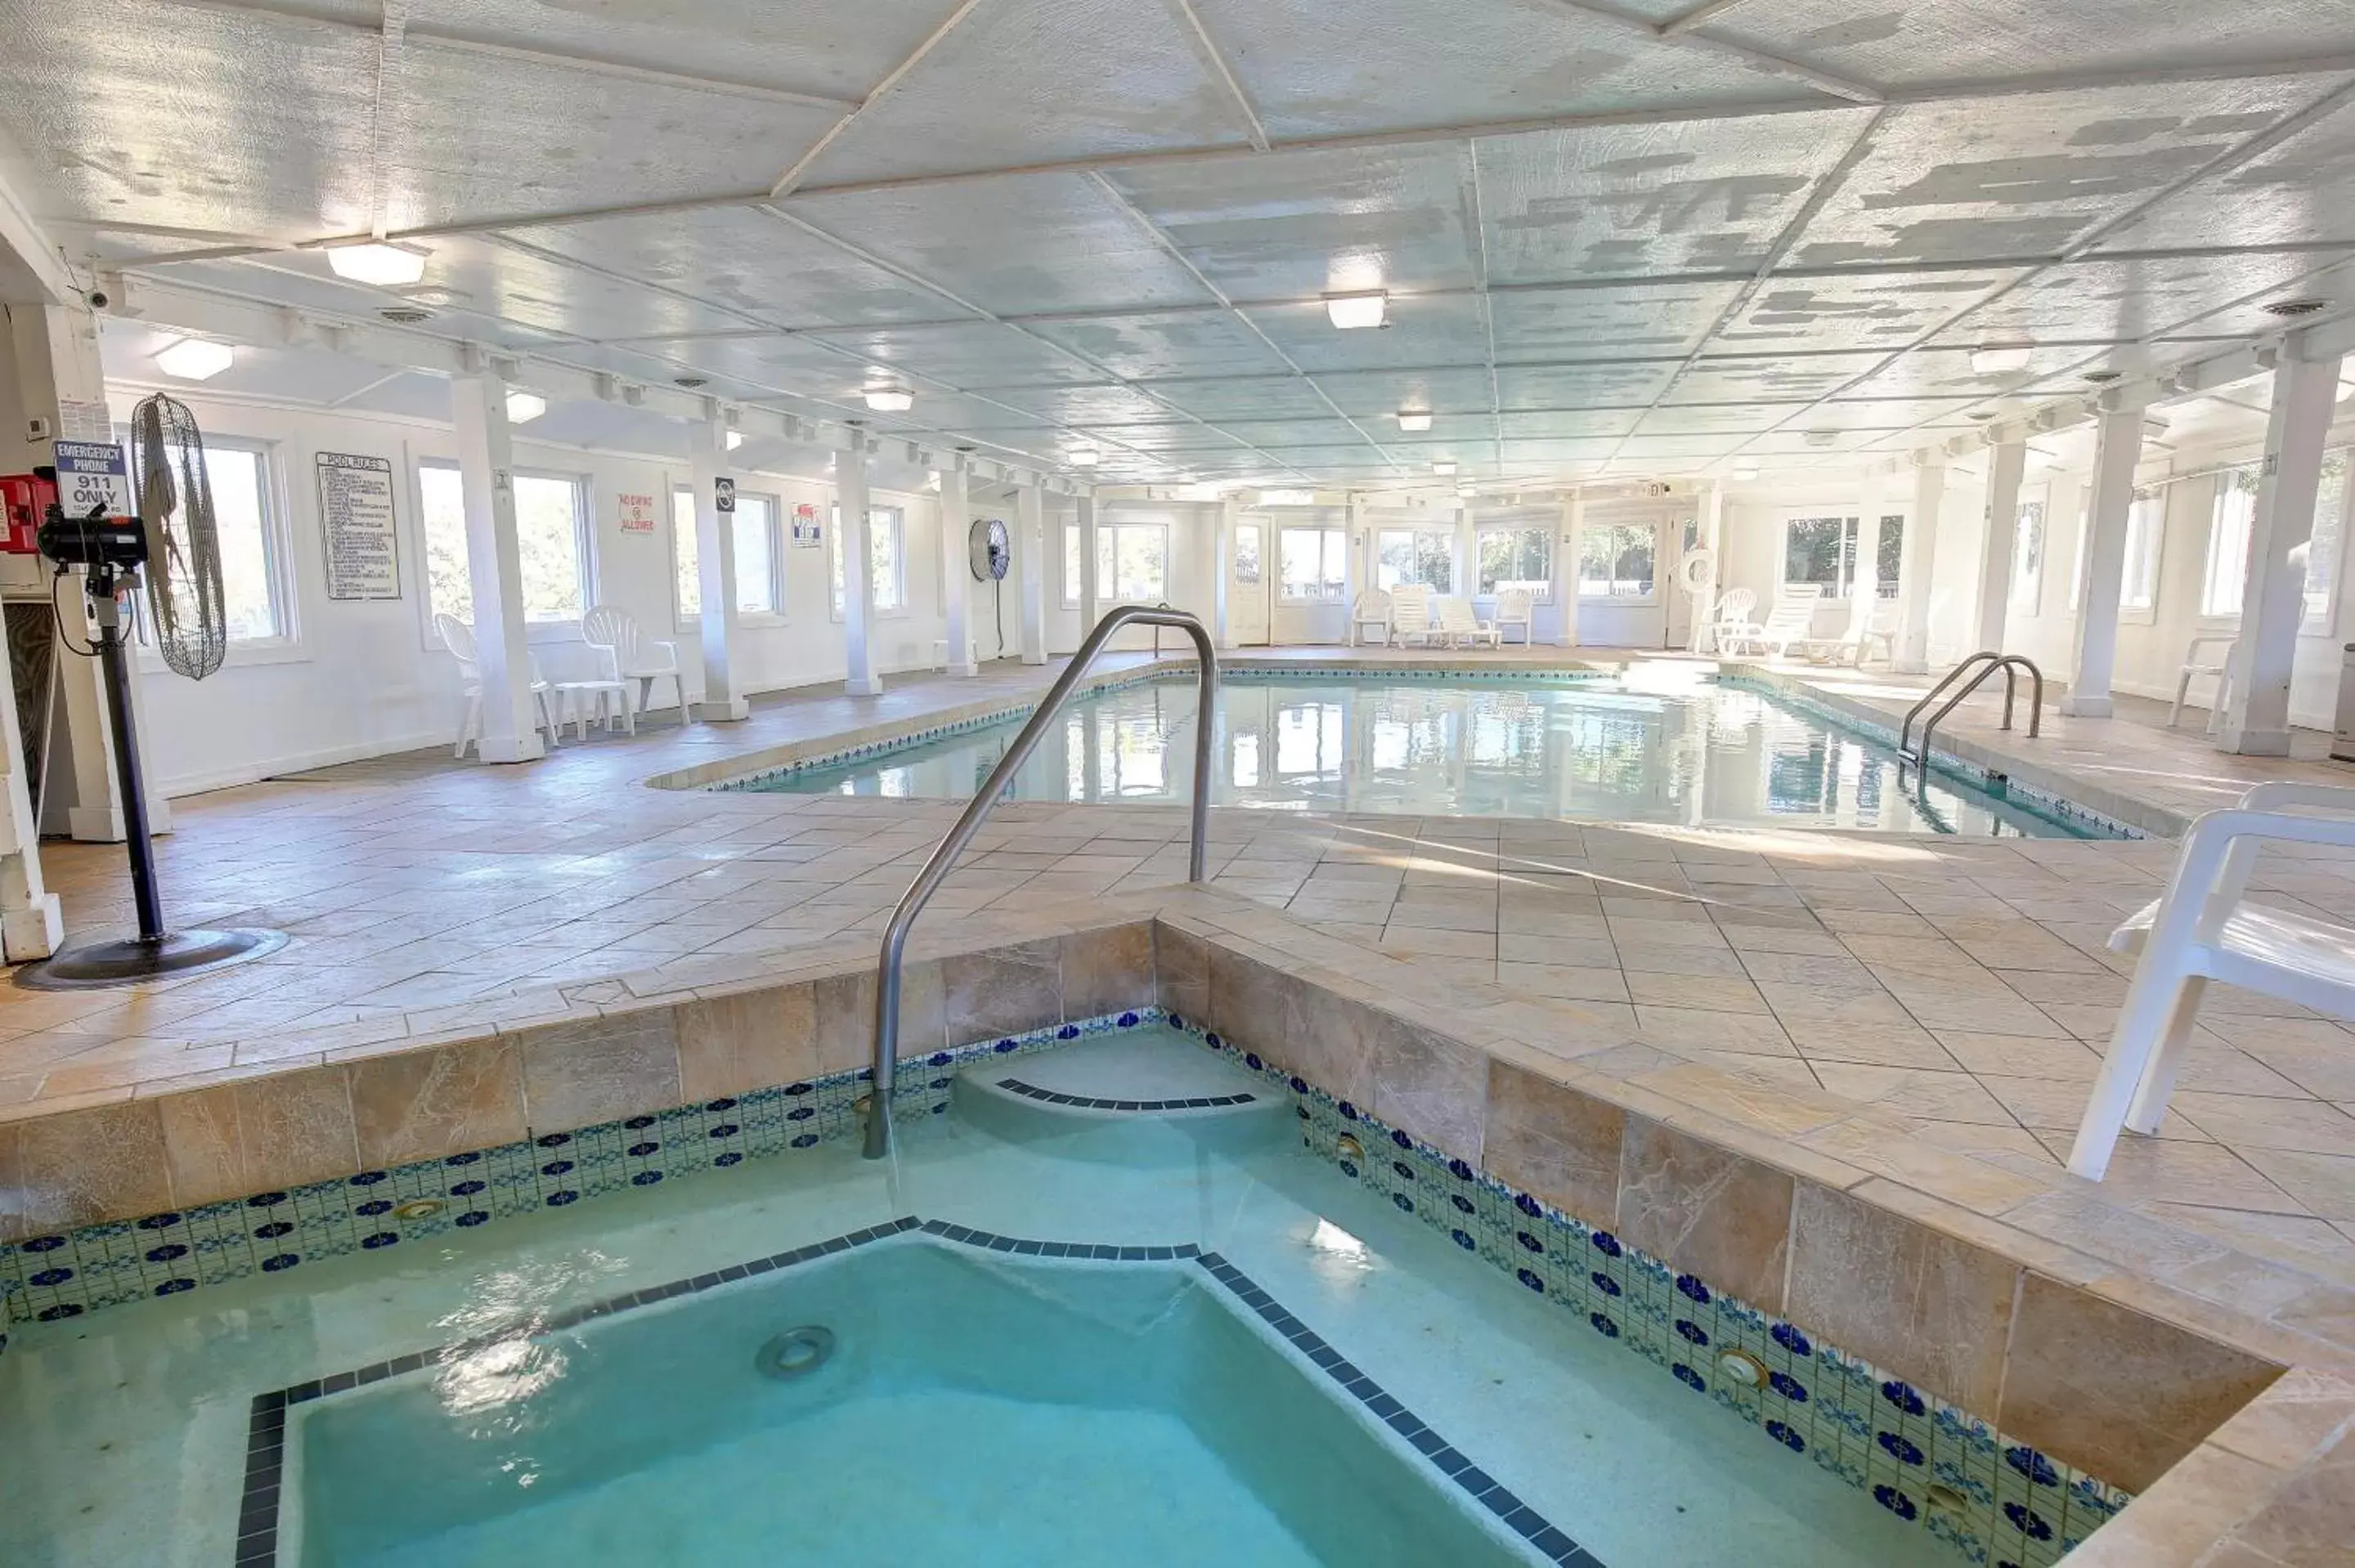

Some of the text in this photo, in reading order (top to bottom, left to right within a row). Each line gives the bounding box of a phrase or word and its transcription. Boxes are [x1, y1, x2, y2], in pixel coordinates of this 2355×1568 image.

[57, 444, 120, 459] EMERGENCY
[74, 459, 110, 473] PHONE
[328, 455, 350, 466] POOL
[78, 475, 111, 489] 911
[74, 490, 116, 504] ONLY
